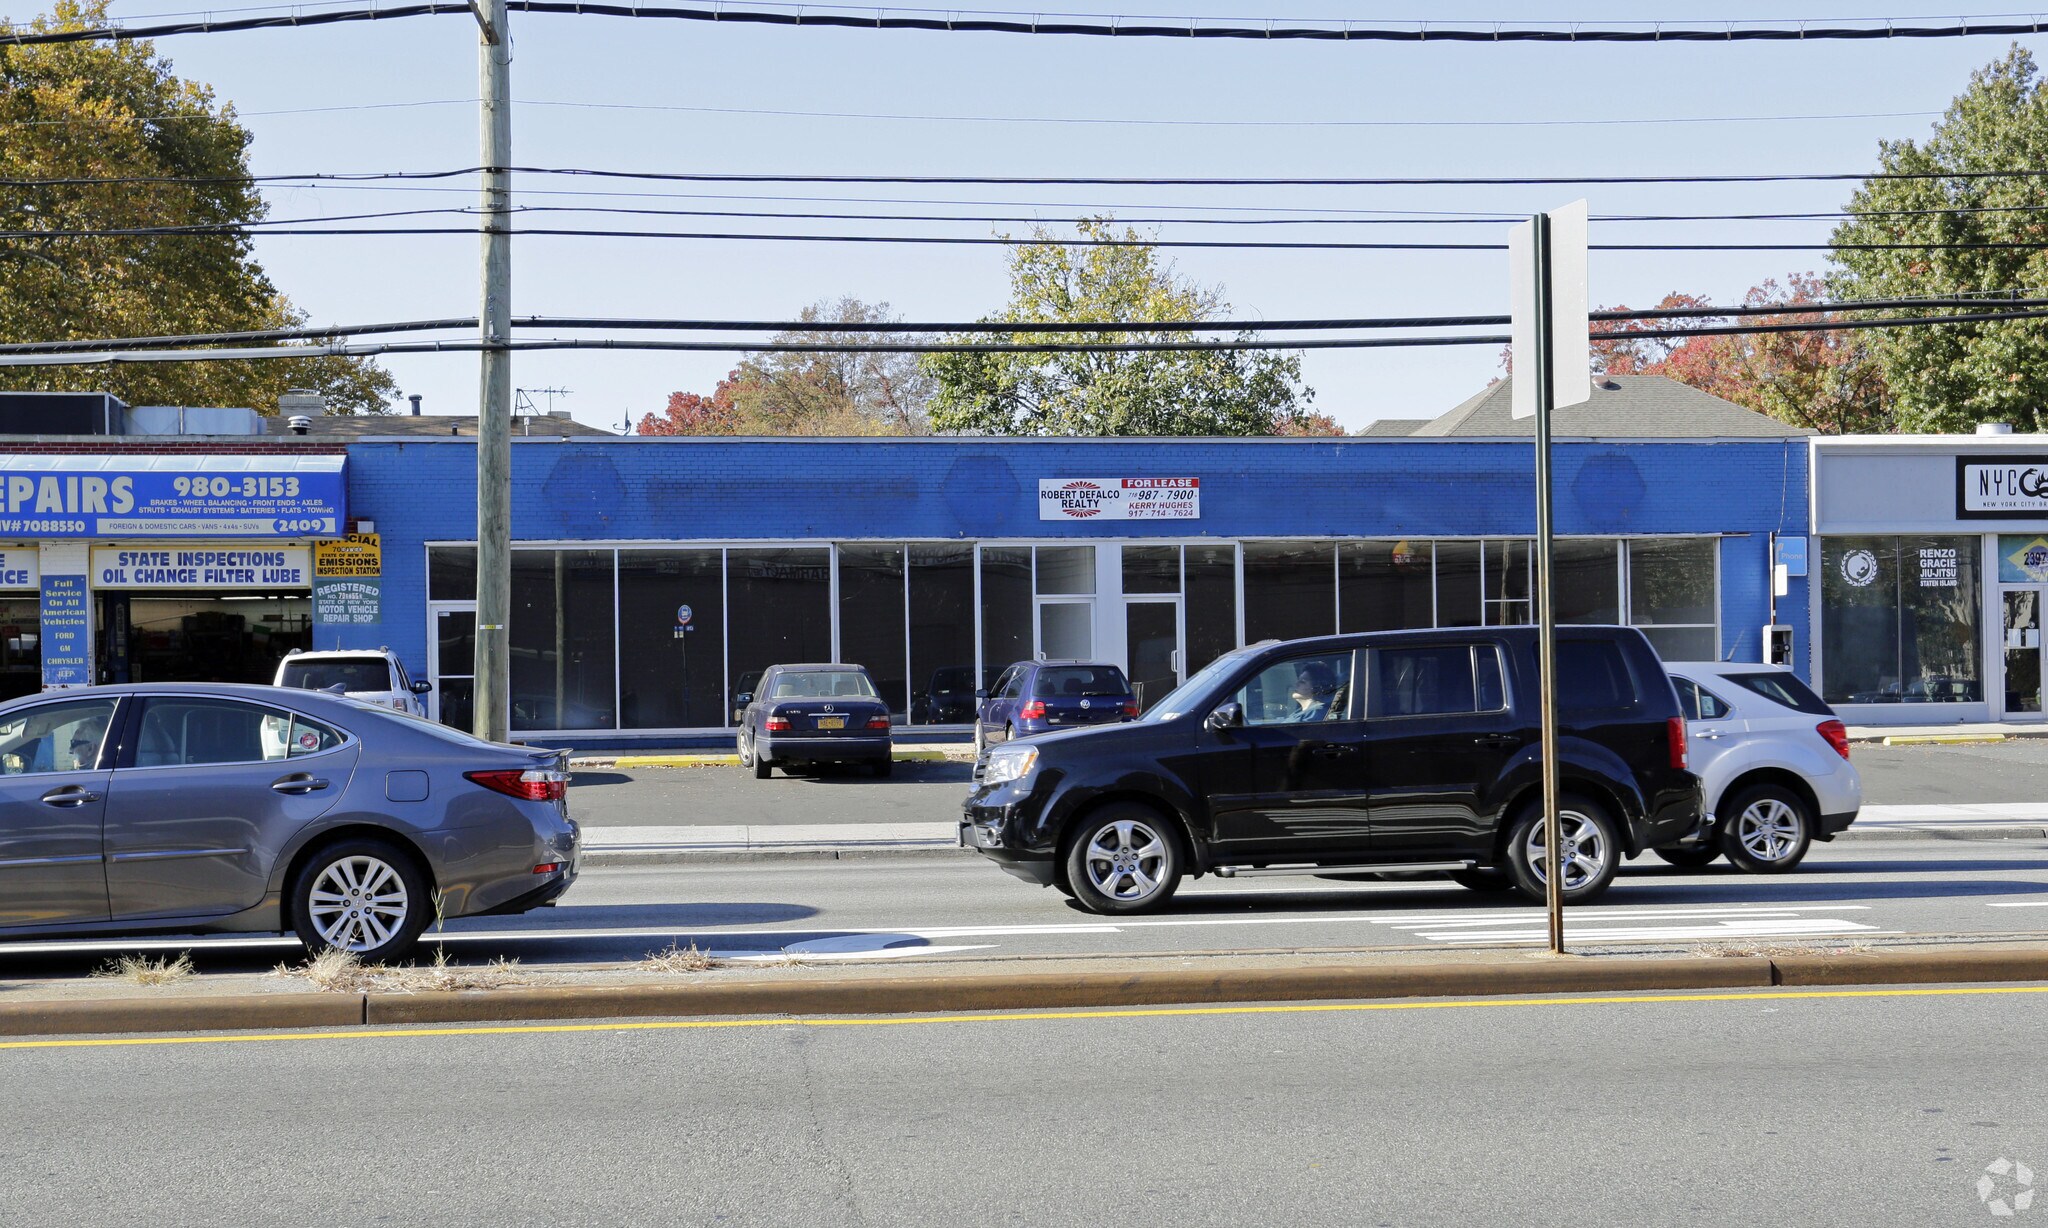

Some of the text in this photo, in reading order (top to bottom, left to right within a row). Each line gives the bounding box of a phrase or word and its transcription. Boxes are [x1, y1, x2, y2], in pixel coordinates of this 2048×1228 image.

[173, 477, 299, 497] 980-3153
[1155, 479, 1192, 487] LEASE
[0, 476, 134, 514] PAIRS
[1041, 490, 1119, 499] ROBERT DEFALCO
[1062, 499, 1099, 508] REALTY
[1920, 549, 1956, 557] RENZO
[119, 552, 285, 566] STATE INSPECTIONS
[319, 558, 378, 566] EMISSIONS
[1920, 559, 1956, 567] GRACIE
[2024, 552, 2047, 565] 2397
[103, 569, 300, 583] OIL CHANGE FILTER LUBE
[1920, 569, 1956, 577] JIU-JITSU
[317, 583, 379, 596] REGISTERED
[324, 614, 373, 622] REPAIR SHOP
